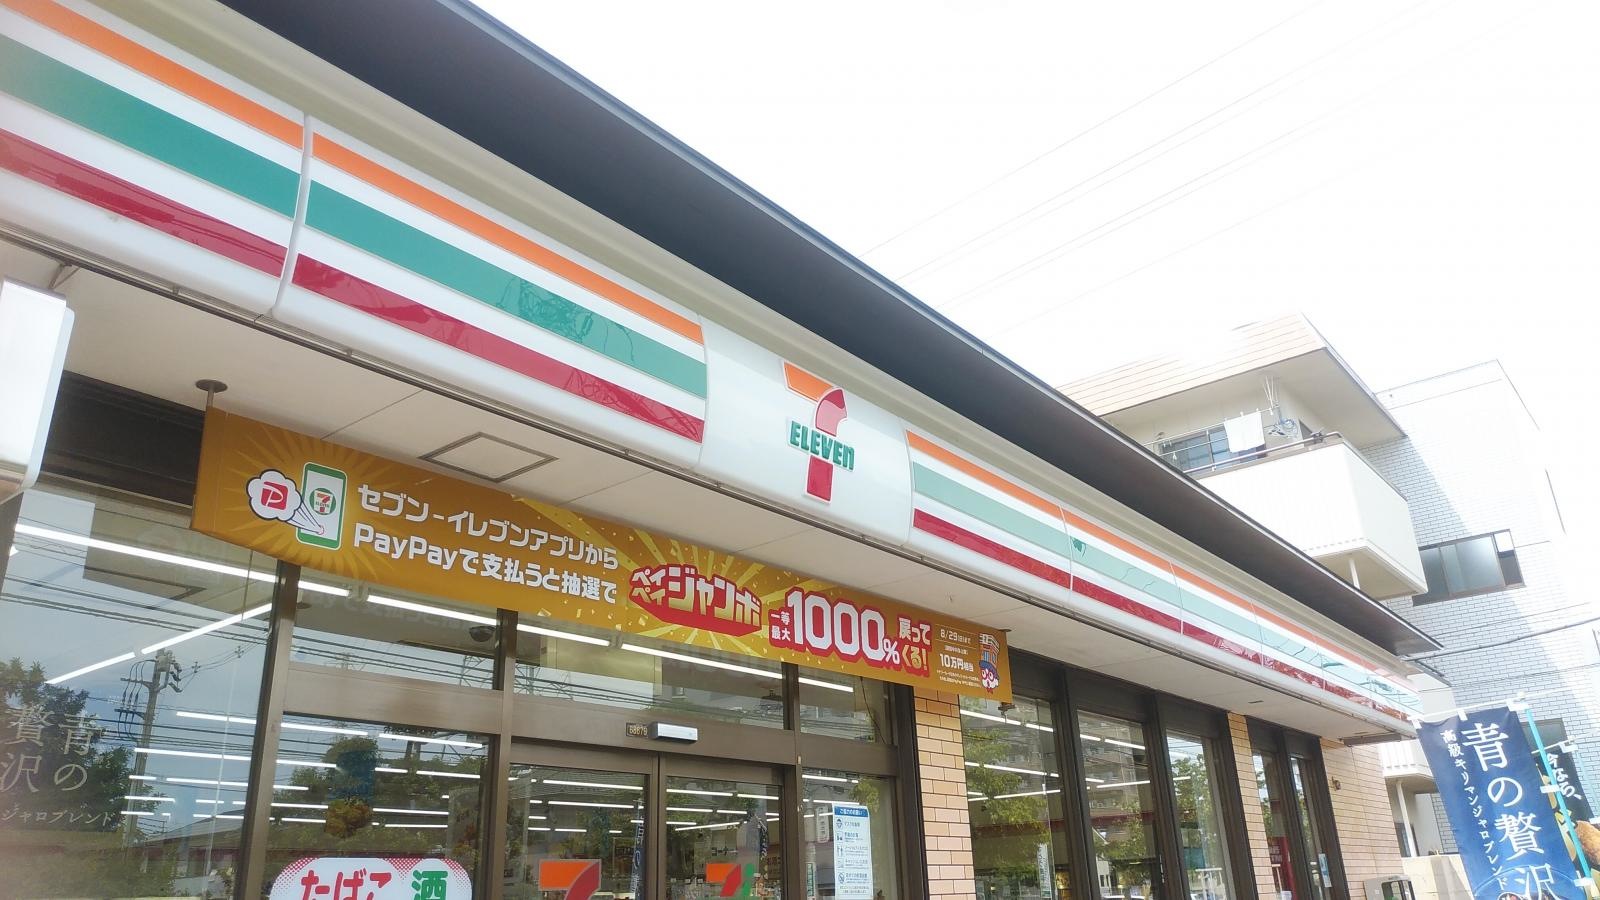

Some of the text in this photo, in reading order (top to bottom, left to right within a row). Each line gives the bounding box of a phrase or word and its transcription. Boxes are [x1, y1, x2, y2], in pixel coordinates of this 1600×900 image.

[790, 420, 855, 472] ELEVEN
[353, 522, 618, 604] PayPayで支払うと抽選で
[668, 566, 761, 627] ジャンボ
[771, 611, 791, 626] 一等
[771, 626, 791, 641] 最大
[787, 590, 901, 665] 1000%
[898, 616, 931, 645] 戻って
[939, 653, 974, 672] 10万円相当
[1440, 729, 1507, 890] 高級キリマンジャロブレンド
